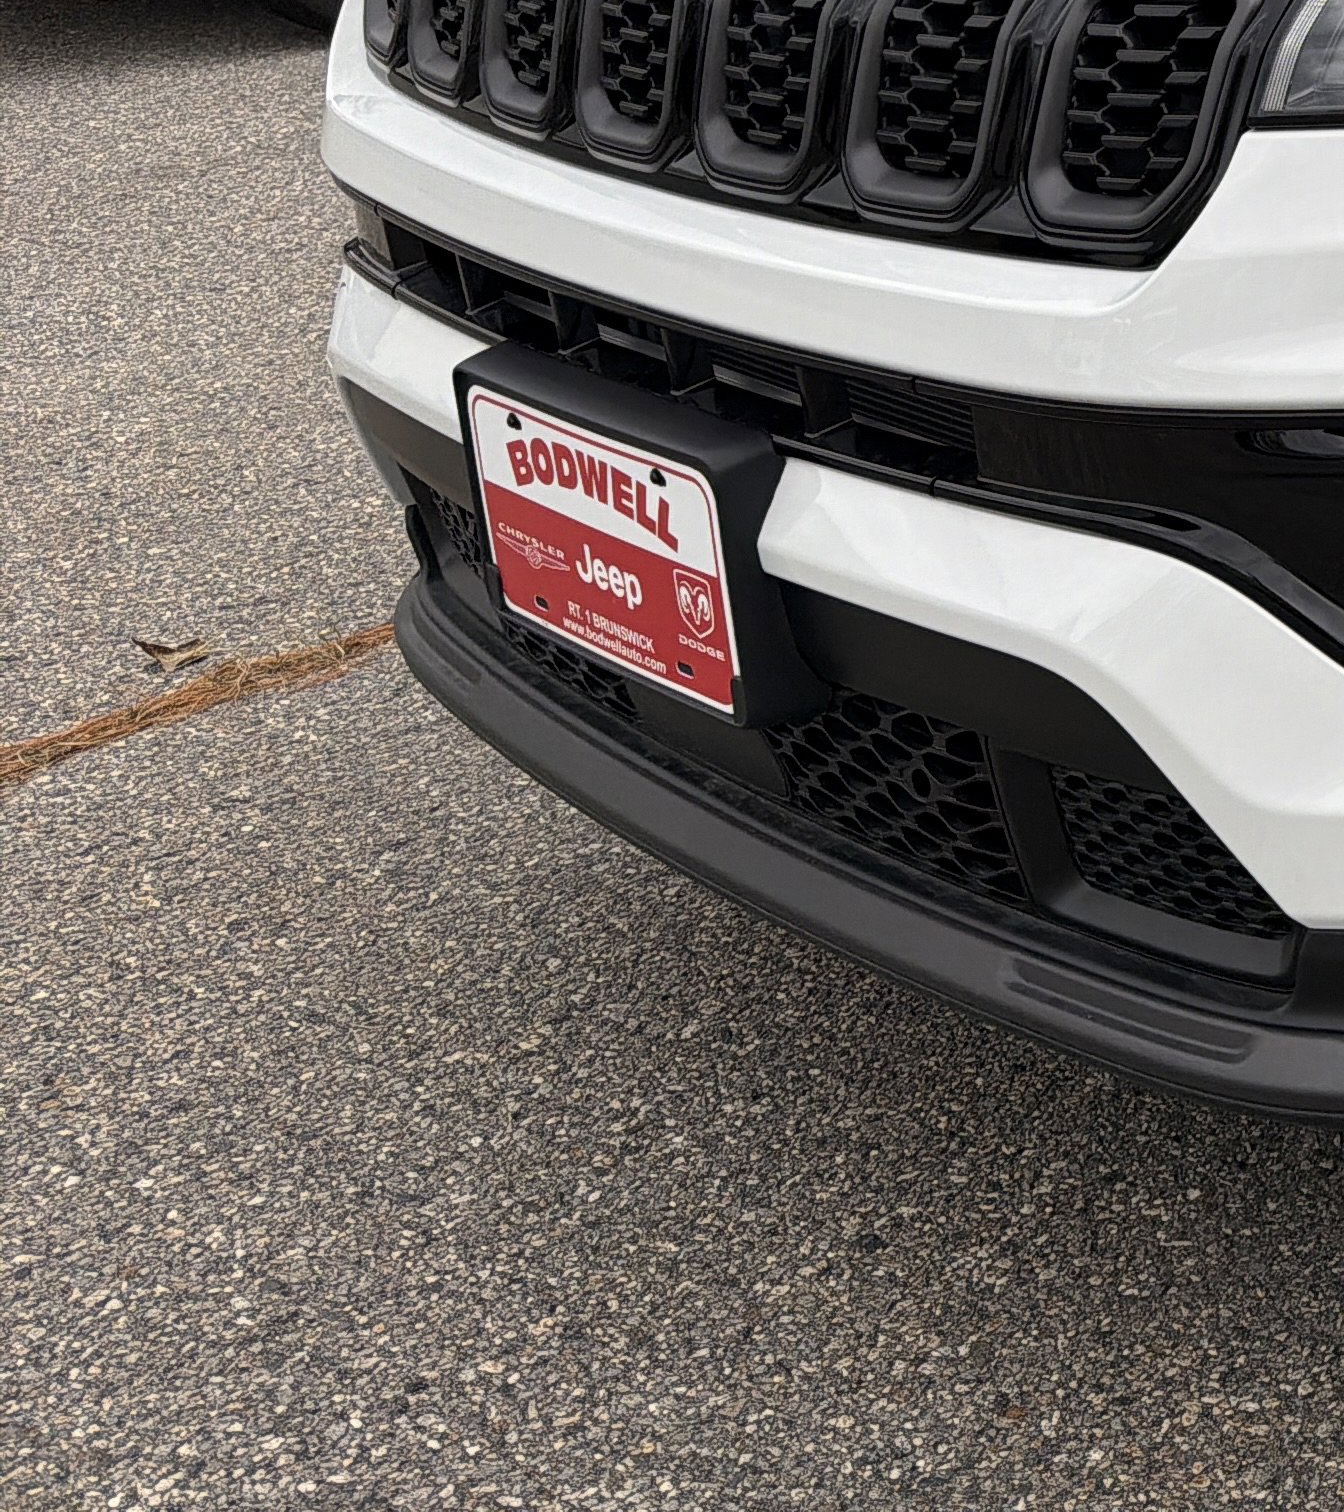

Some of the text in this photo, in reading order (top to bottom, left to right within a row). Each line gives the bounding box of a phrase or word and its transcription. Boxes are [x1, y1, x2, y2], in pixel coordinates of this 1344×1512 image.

[506, 438, 679, 553] BODWELL
[498, 522, 565, 560] CHRYSLER
[576, 543, 643, 610] Jeep
[563, 617, 666, 675] www.bodwellauto.com
[567, 600, 583, 620] RT.
[592, 613, 656, 654] BRUNSWICK
[678, 633, 726, 662] DODGE
